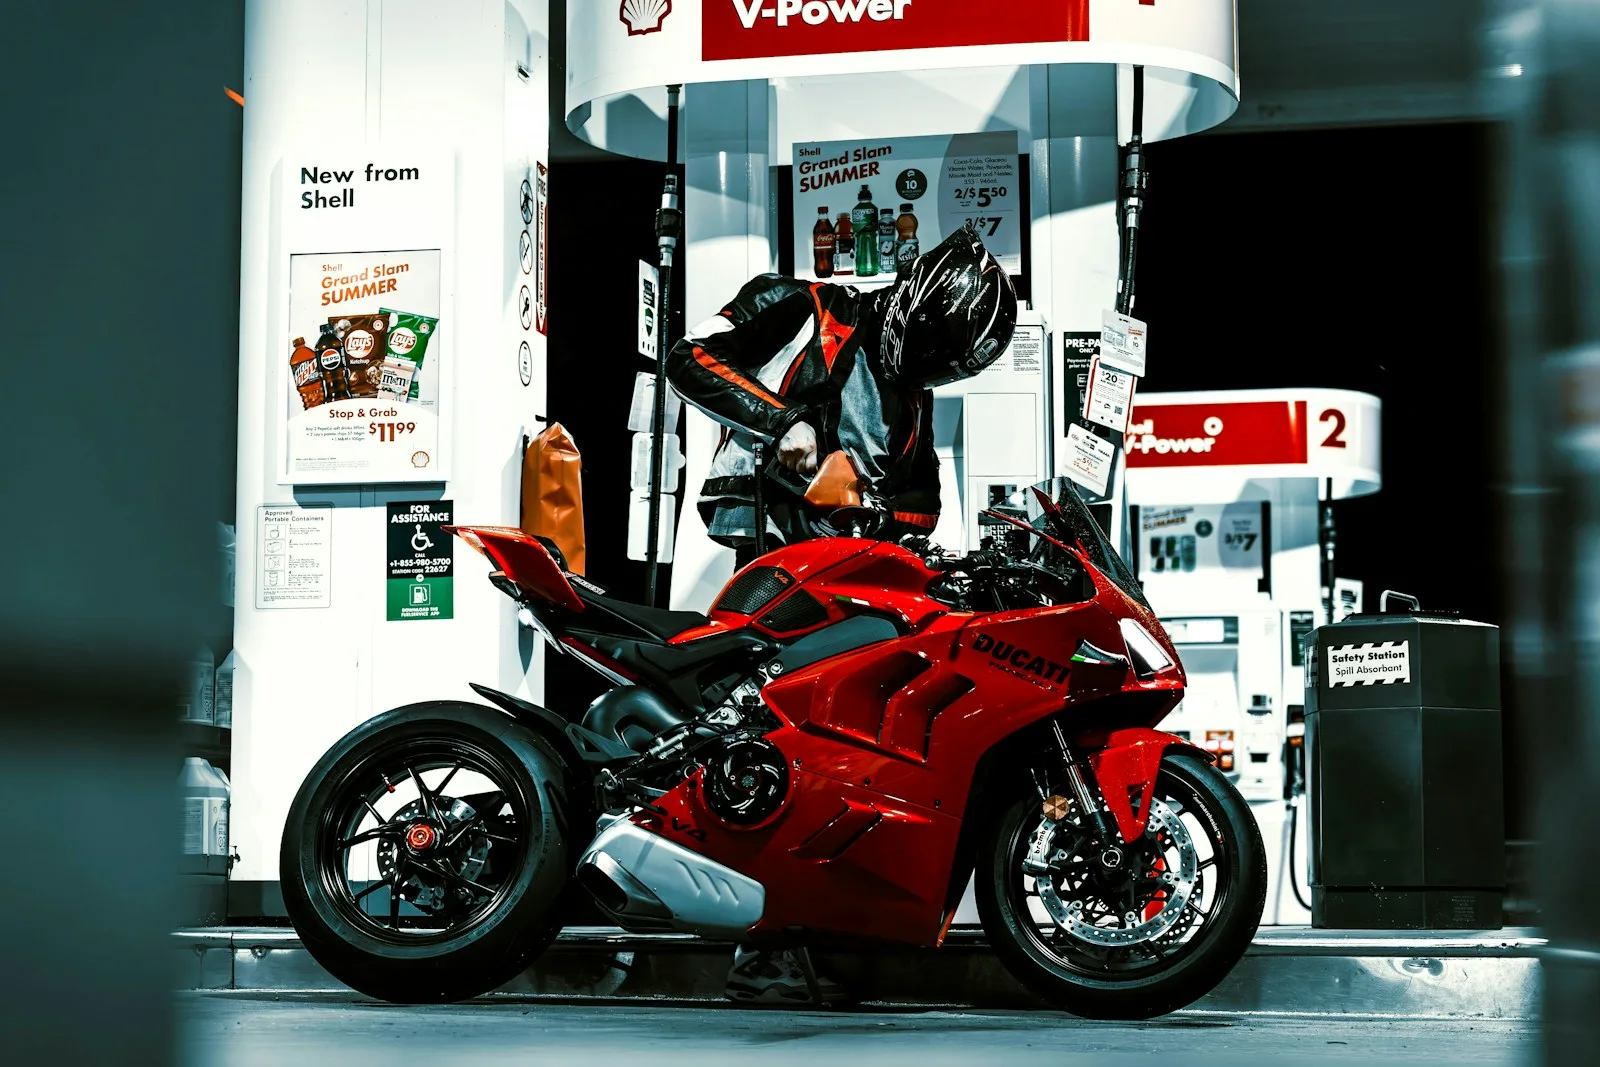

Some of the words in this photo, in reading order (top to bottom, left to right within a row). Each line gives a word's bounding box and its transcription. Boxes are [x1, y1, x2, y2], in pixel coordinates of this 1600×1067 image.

[732, 0, 912, 28] V-Power
[799, 148, 820, 156] Shell
[799, 151, 848, 174] Grand
[853, 146, 892, 162] Slam
[301, 167, 354, 185] New
[365, 163, 419, 182] from
[800, 161, 880, 192] SUMMER
[905, 180, 917, 190] 10
[300, 189, 354, 210] Shell
[322, 268, 369, 288] Grand
[373, 263, 409, 278] Slam
[321, 278, 398, 306] SUMMER
[348, 336, 372, 350] Lay's
[1066, 339, 1100, 348] PRE-PA
[330, 409, 354, 420] Stop
[358, 408, 365, 418] &
[370, 407, 398, 417] Grab
[1318, 408, 1346, 448] 2
[410, 505, 430, 513] FOR
[391, 513, 449, 523] ASSISTANCE
[390, 558, 451, 567] +1-855-980-5700
[775, 571, 788, 584] V4
[972, 633, 1071, 685] DUCATI
[1332, 654, 1364, 663] Safety
[1368, 651, 1405, 660] Station
[1336, 667, 1353, 677] Spill
[1357, 664, 1402, 674] Absorbant
[672, 816, 707, 842] V4
[1034, 826, 1048, 854] brembo
